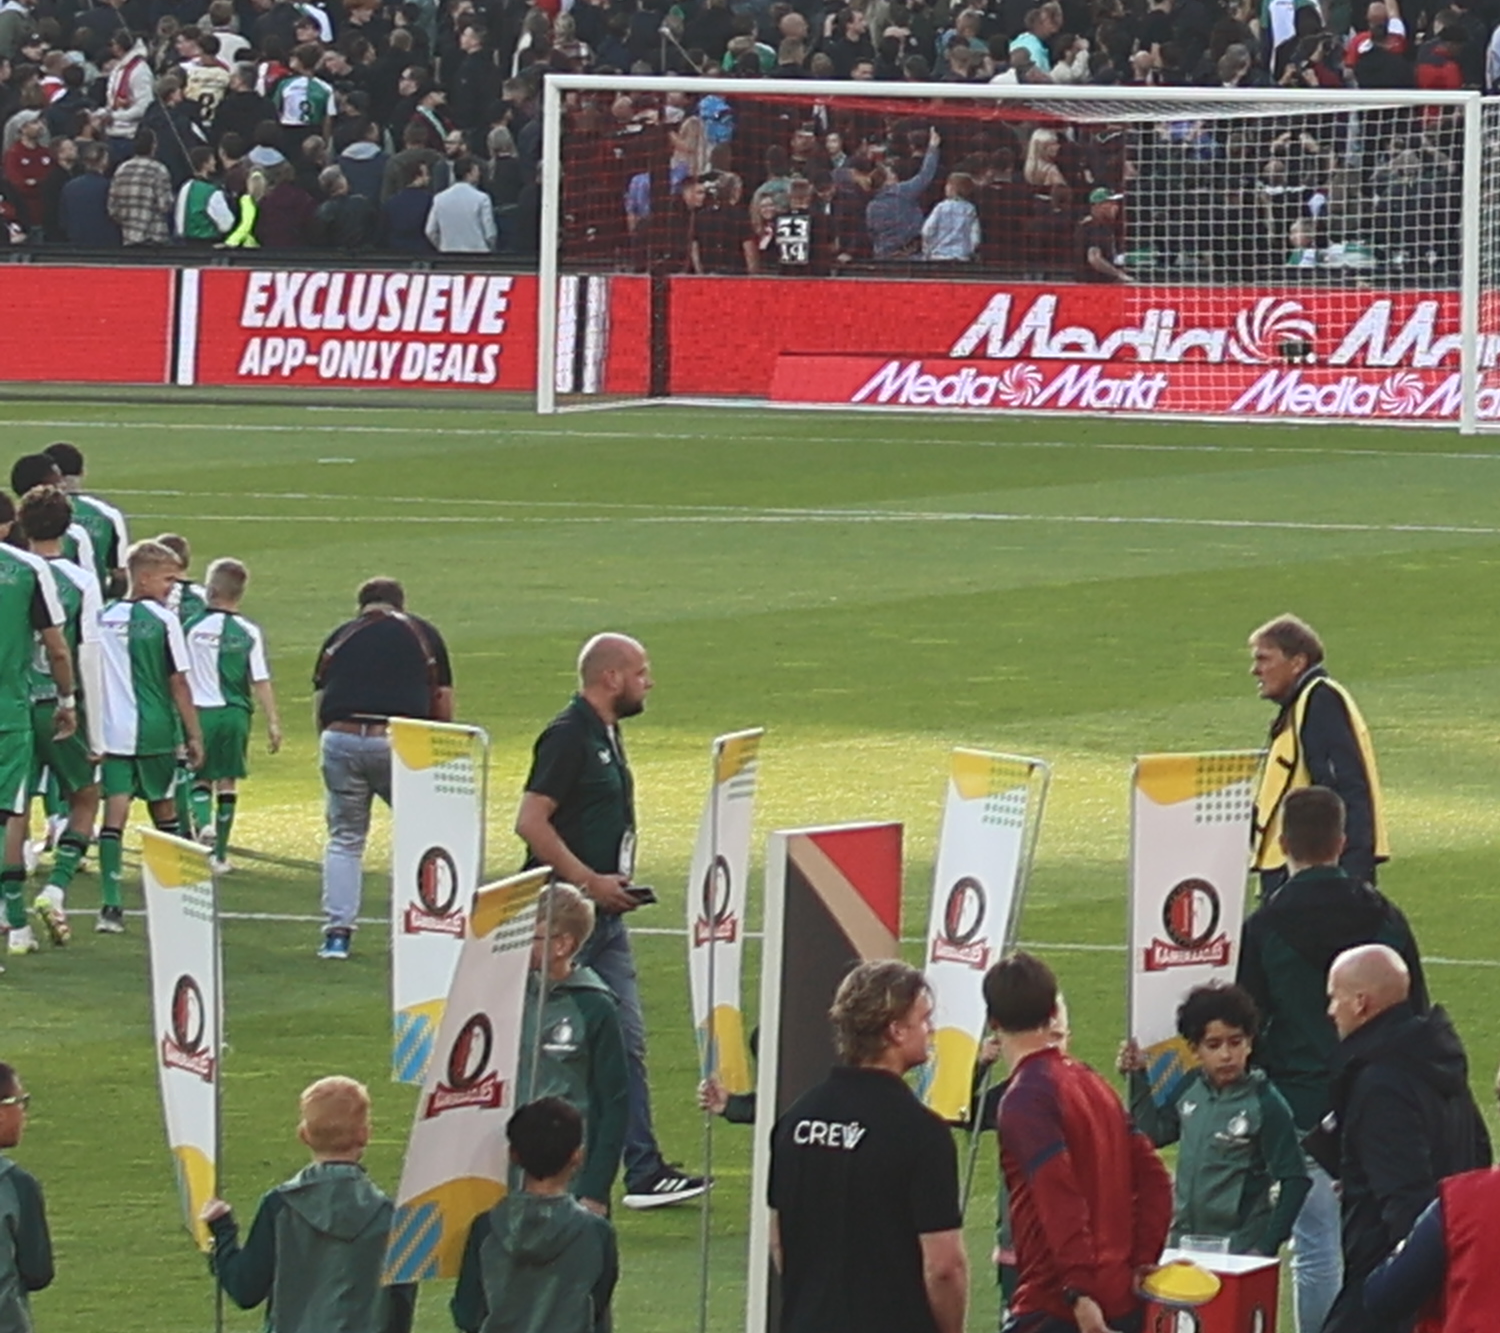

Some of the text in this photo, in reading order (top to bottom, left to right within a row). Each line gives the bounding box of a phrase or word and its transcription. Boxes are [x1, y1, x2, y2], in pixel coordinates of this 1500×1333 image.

[240, 271, 511, 334] EXCLUSIEVE
[951, 293, 1230, 362] Media
[238, 337, 499, 385] APP-ONLY DEALS
[852, 360, 1168, 410] Media Markt
[1230, 369, 1380, 416] Media
[793, 1119, 866, 1149] CREW
